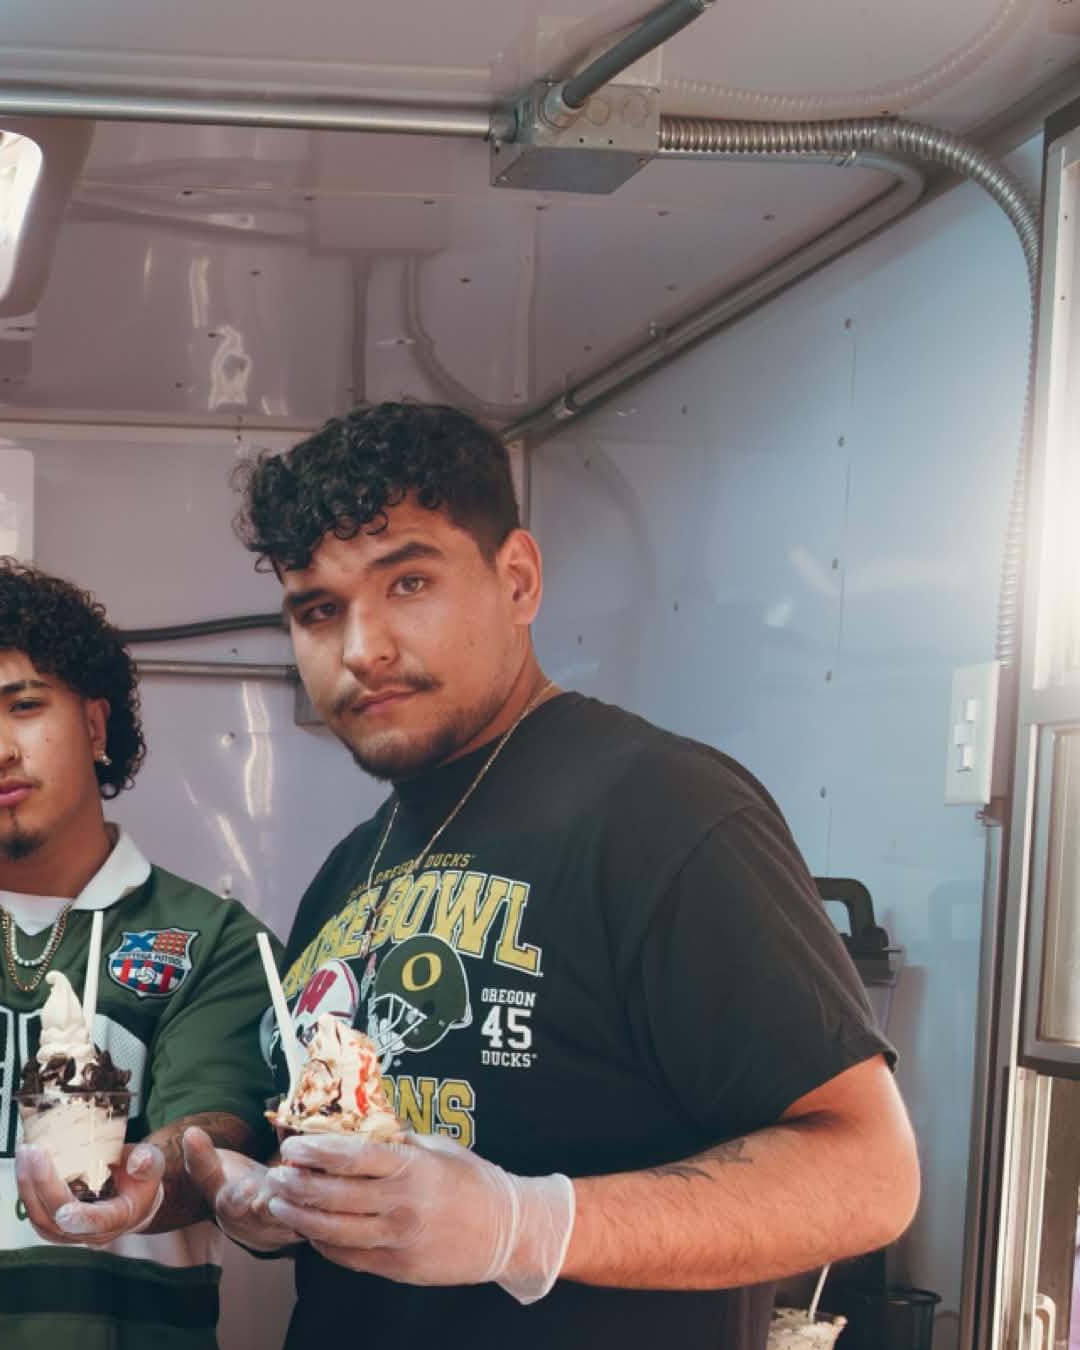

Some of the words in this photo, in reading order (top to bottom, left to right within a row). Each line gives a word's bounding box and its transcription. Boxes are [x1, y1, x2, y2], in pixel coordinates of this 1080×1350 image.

[371, 871, 542, 976] BOWL
[401, 951, 442, 991] O
[481, 987, 536, 1008] OREGON
[481, 1005, 532, 1050] 45
[481, 1050, 532, 1068] DUCKS
